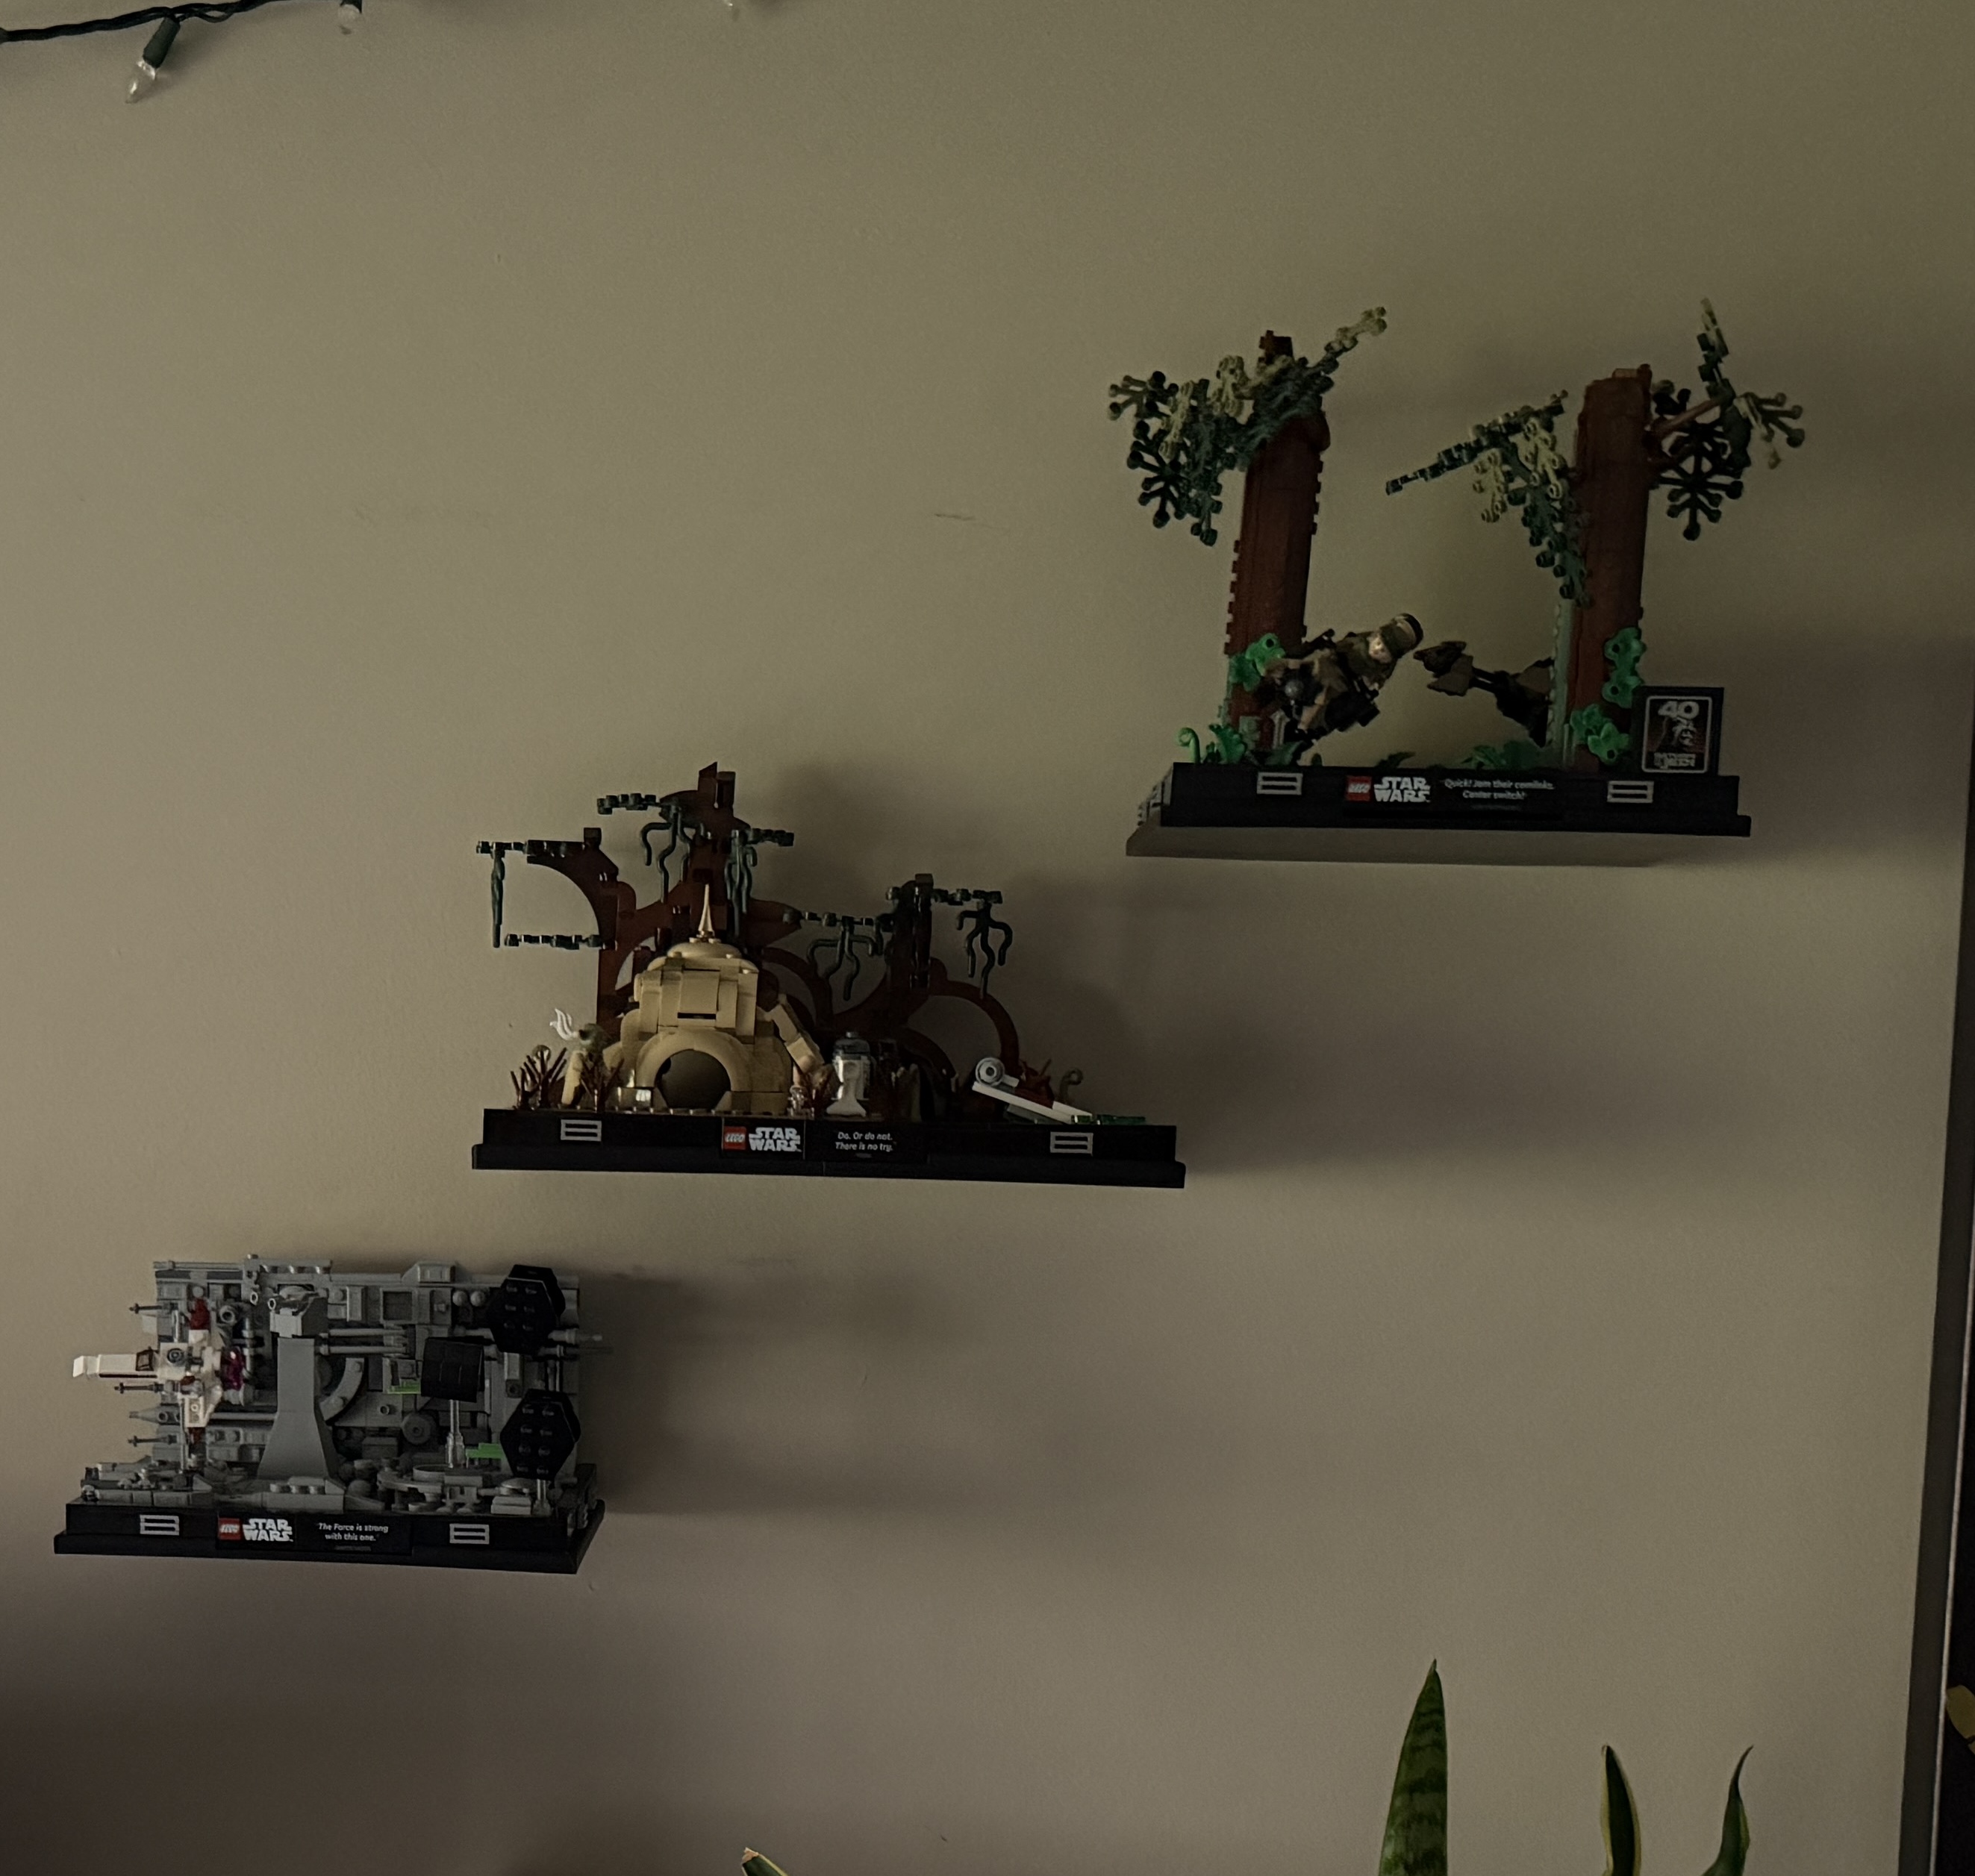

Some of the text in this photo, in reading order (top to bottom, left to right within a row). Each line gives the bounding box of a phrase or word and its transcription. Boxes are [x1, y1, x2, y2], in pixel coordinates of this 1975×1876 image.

[1658, 701, 1700, 720] 40
[1373, 776, 1431, 790] STAR
[1373, 789, 1431, 802] WARS
[725, 1133, 745, 1142] LEGO
[749, 1127, 801, 1140] STAR
[852, 1131, 864, 1139] Or
[864, 1131, 876, 1140] do
[749, 1139, 802, 1152] WARS
[835, 1141, 858, 1150] There
[858, 1141, 866, 1151] is
[243, 1518, 293, 1530] STAR
[318, 1522, 389, 1533] The Force is strong
[243, 1529, 293, 1542] WARS
[325, 1532, 343, 1540] with
[343, 1532, 358, 1541] this
